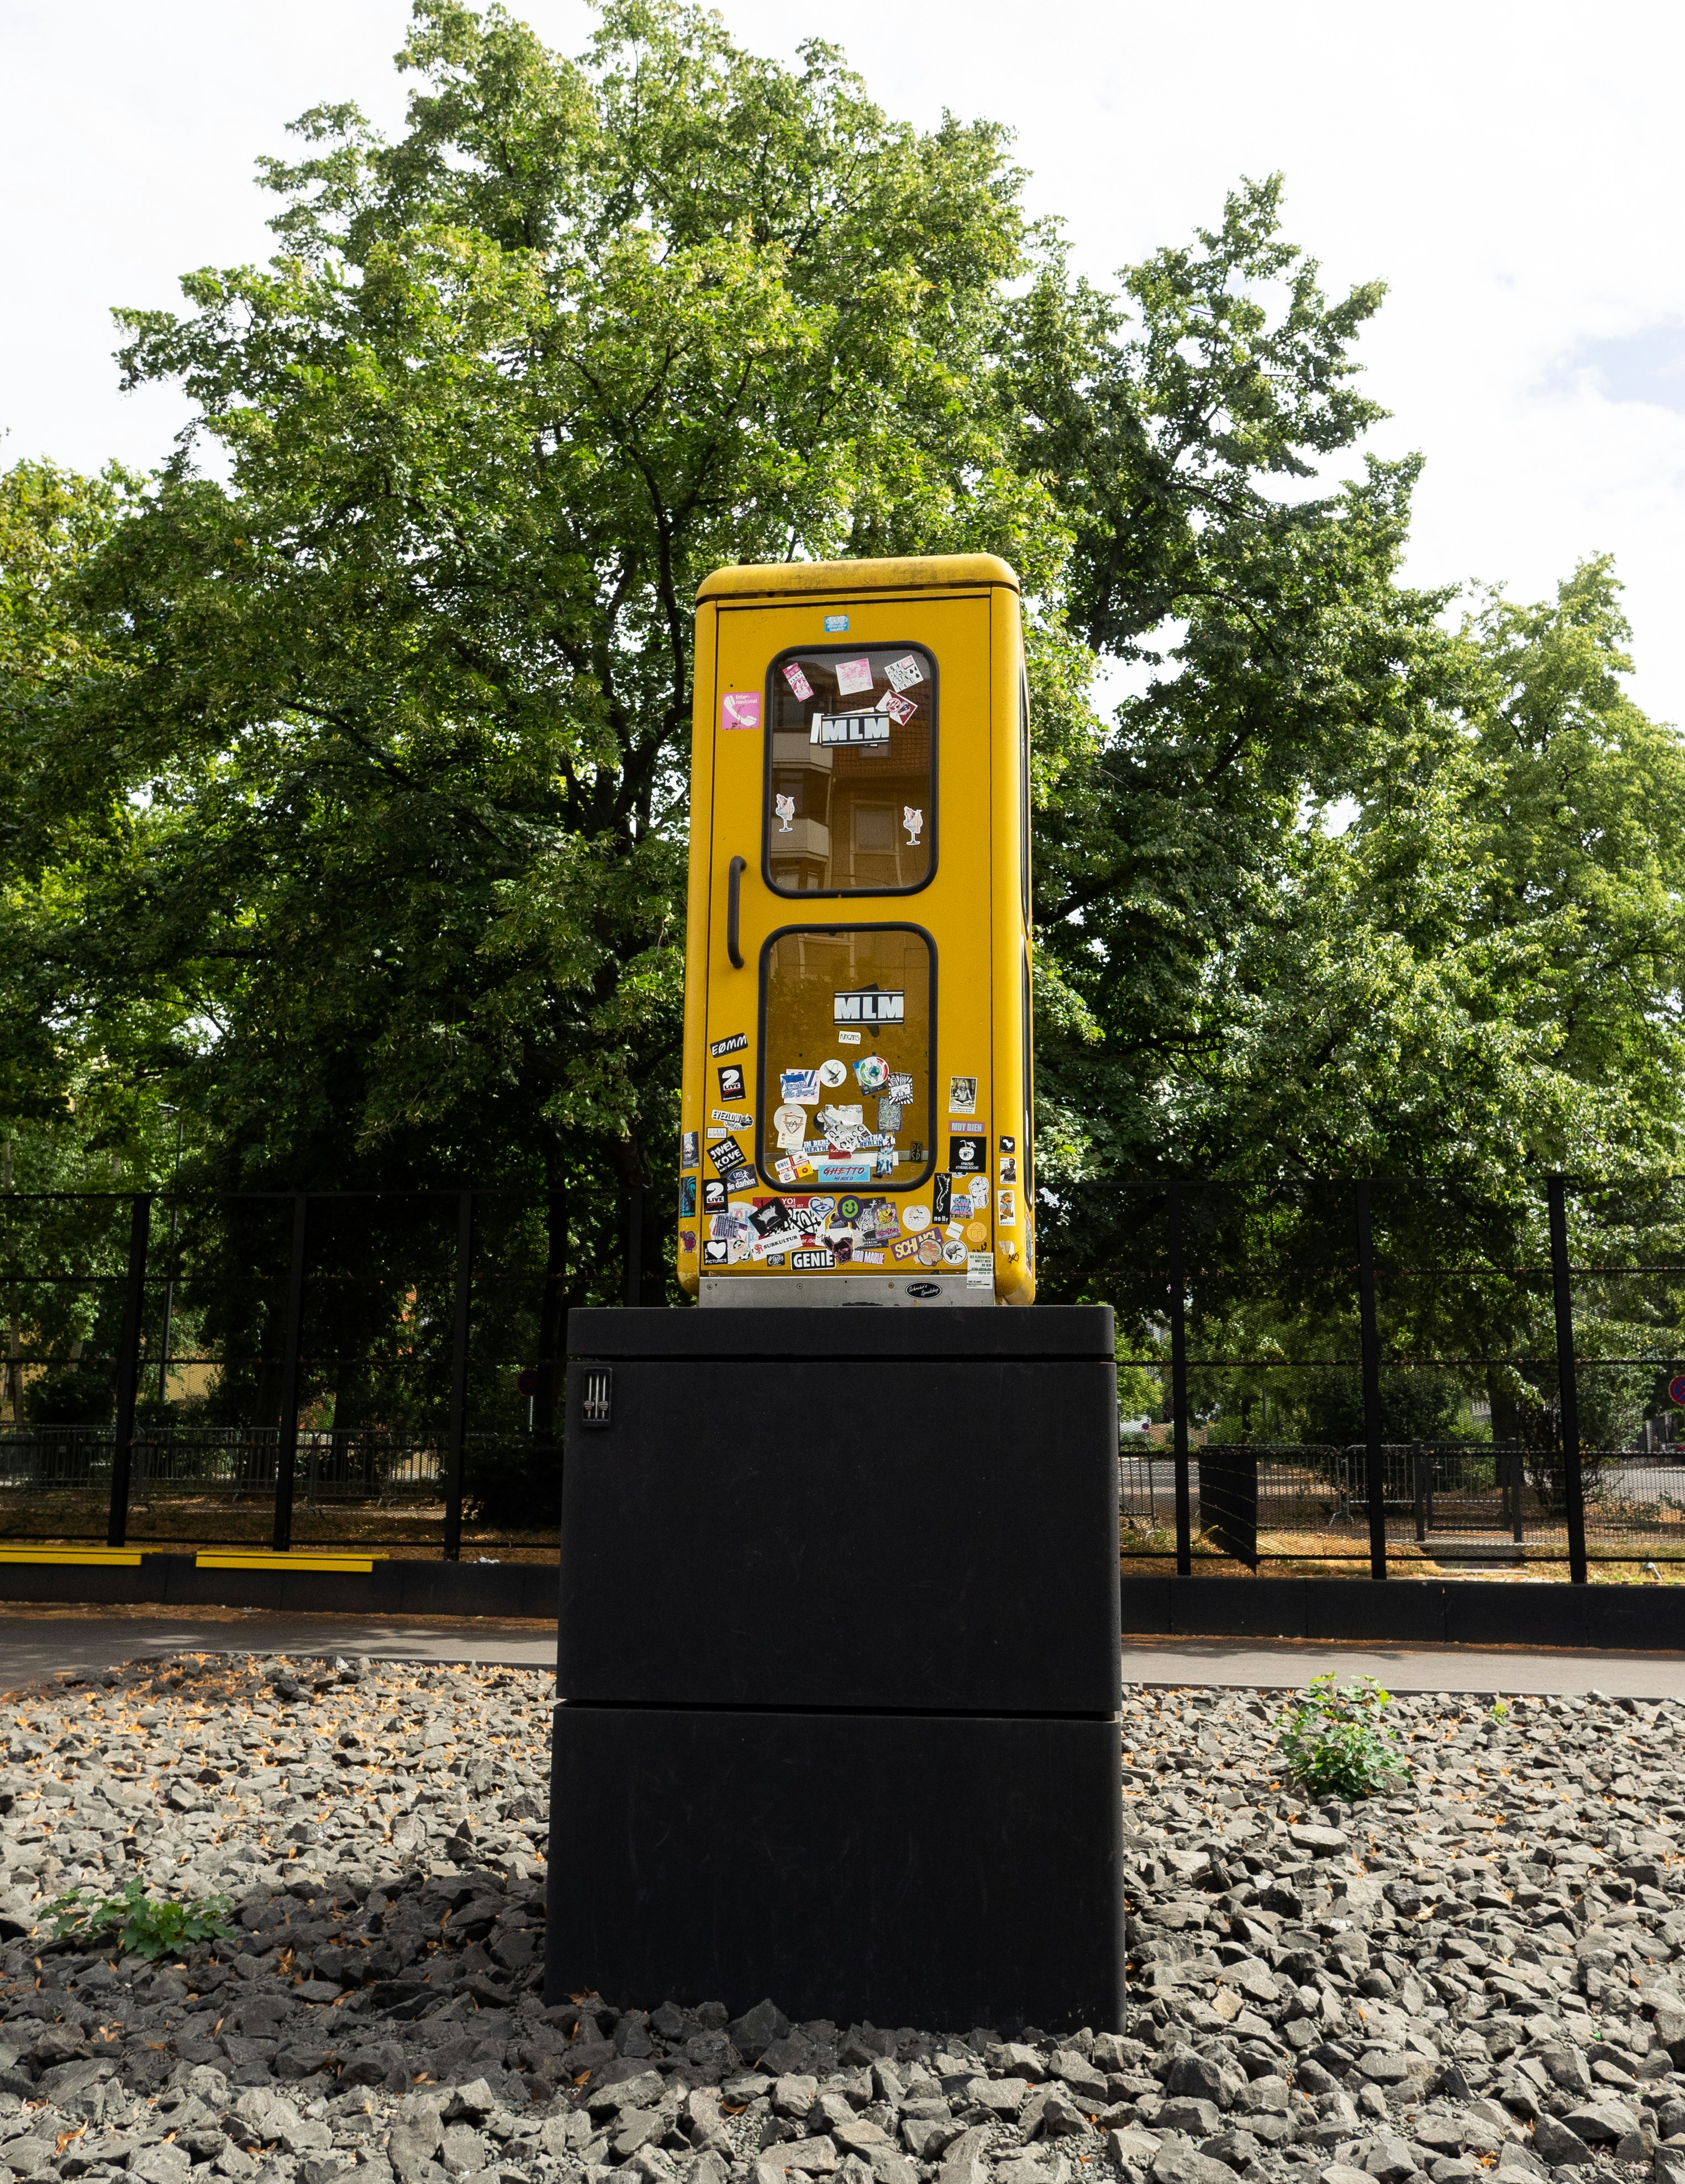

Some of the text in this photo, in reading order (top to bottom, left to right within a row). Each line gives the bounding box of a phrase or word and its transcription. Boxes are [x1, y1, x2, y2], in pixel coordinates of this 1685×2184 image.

[823, 718, 889, 741] MLM
[834, 996, 904, 1019] MLM
[712, 1035, 746, 1056] EØMM
[722, 1069, 740, 1088] 2
[951, 1123, 982, 1132] MUY BIEN
[714, 1149, 741, 1168] KOVE
[777, 1160, 789, 1169] BWFC
[823, 1166, 865, 1176] GHETTO
[706, 1183, 724, 1200] 2
[735, 1178, 756, 1189] damen
[763, 1235, 798, 1249] SUBKULTUR
[794, 1252, 834, 1268] GENIE
